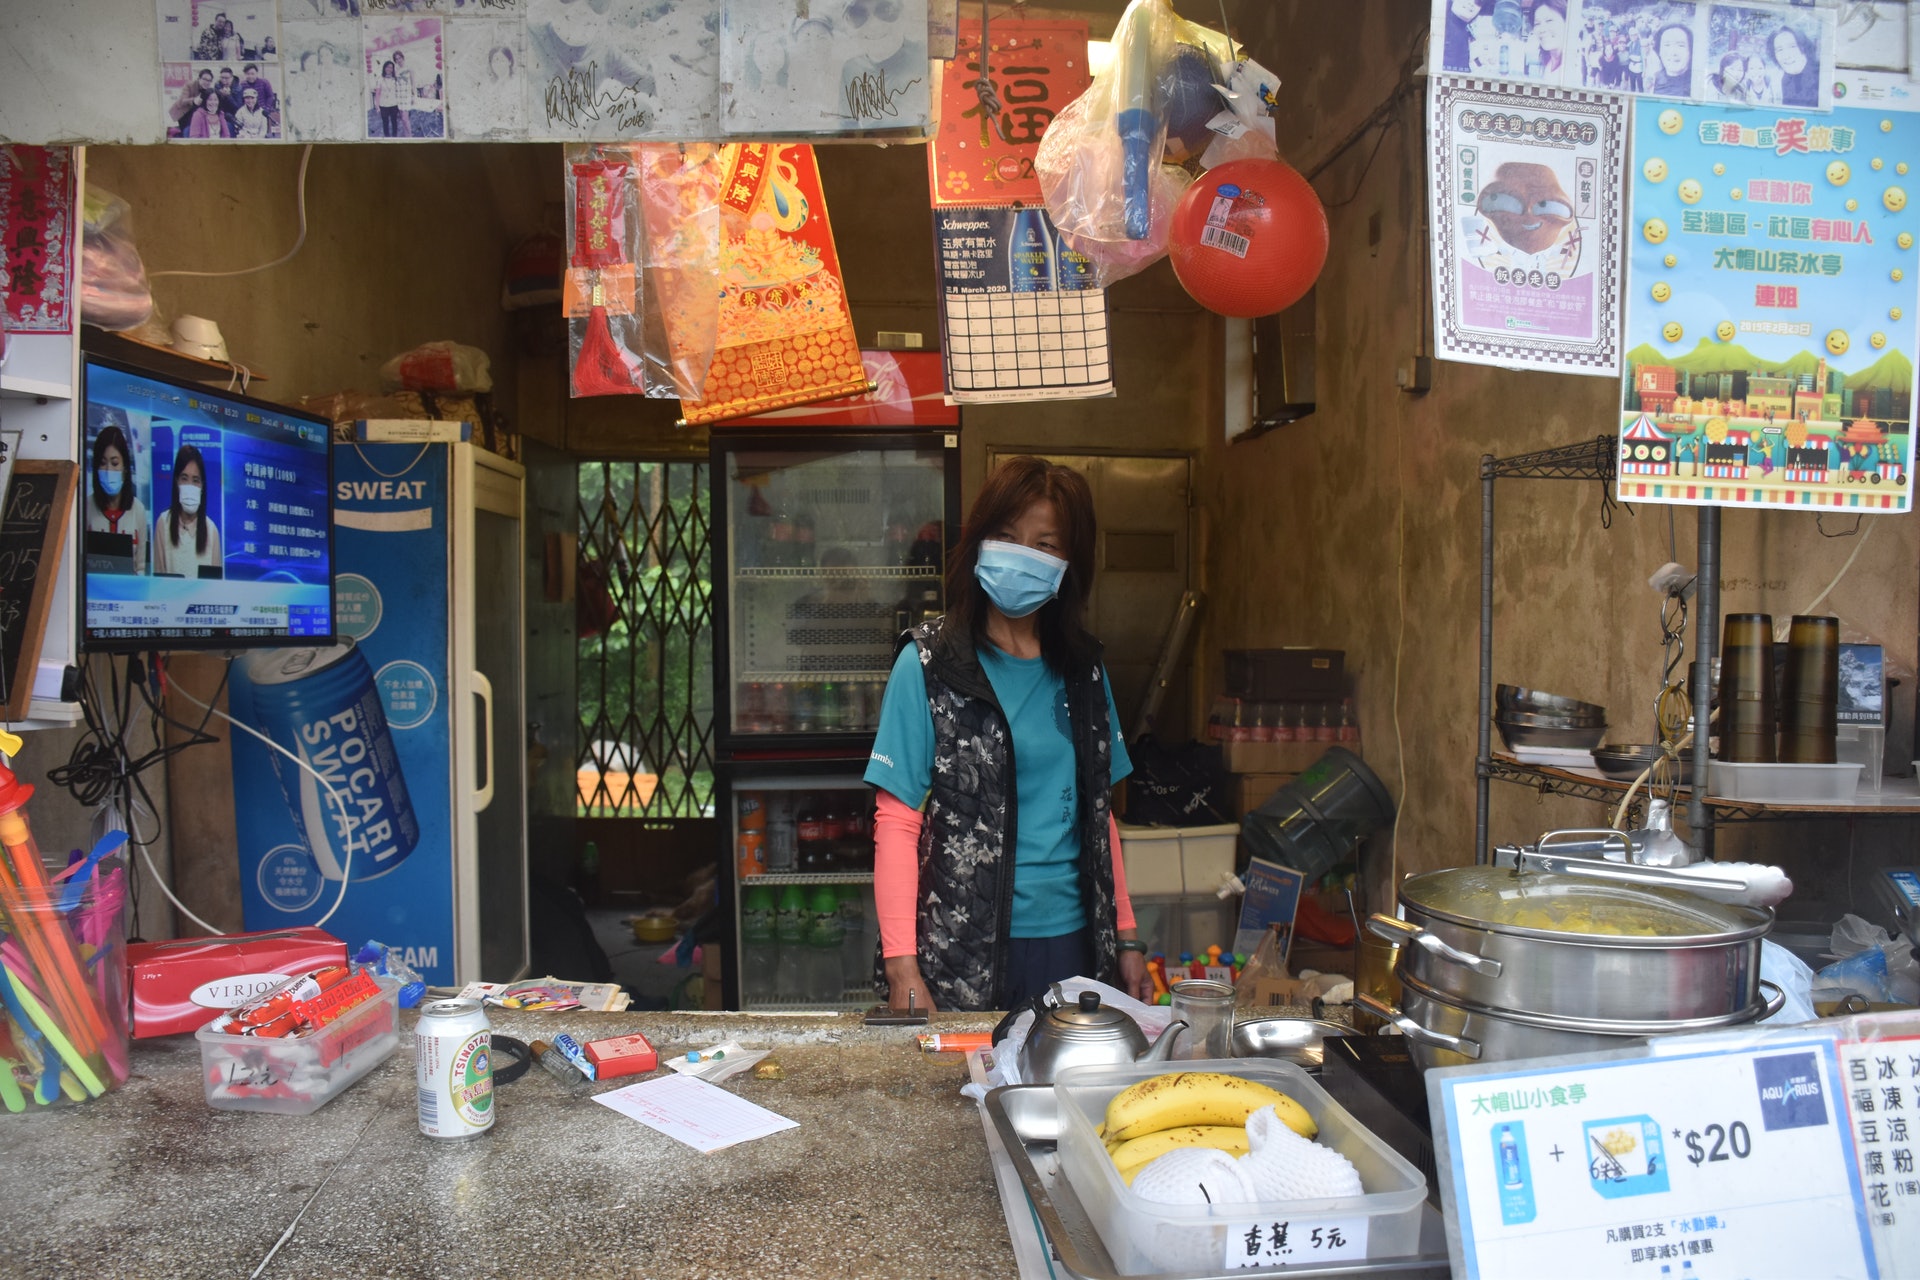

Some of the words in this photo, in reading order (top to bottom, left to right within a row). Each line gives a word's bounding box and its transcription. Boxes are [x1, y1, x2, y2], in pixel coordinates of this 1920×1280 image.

[961, 62, 1055, 148] 福
[1462, 113, 1522, 134] 飯堂走塑
[1536, 121, 1594, 142] 餐具先行
[1748, 180, 1812, 204] 感謝你
[589, 175, 608, 250] 吉祥如意
[941, 219, 990, 231] Schweppes
[1683, 210, 1747, 235] 荃灣區
[1769, 216, 1873, 244] 社區有心人
[1714, 248, 1842, 275] 大帽山茶水亭
[961, 286, 985, 294] March
[987, 285, 1007, 293] 2020
[1496, 270, 1558, 287] 飯堂走塑
[1755, 284, 1798, 309] 連姐
[1740, 321, 1811, 336] 2019年2月23日
[337, 481, 427, 500] SWEAT
[302, 720, 371, 856] SWEAT
[330, 707, 398, 862] POCARI
[288, 977, 307, 995] bueno
[455, 1035, 489, 1077] TSINGTAO
[1471, 1083, 1588, 1116] 大帽山小食亭
[1762, 1079, 1819, 1106] AQUARIUS
[1875, 1055, 1913, 1173] 冰凍涼粉
[1849, 1058, 1891, 1208] 百福豆腐花
[1895, 1179, 1920, 1197] (1客)
[1244, 1221, 1293, 1257] 香蕉
[1311, 1227, 1347, 1250] 5元
[1631, 1238, 1714, 1264] 即享減$1優惠
